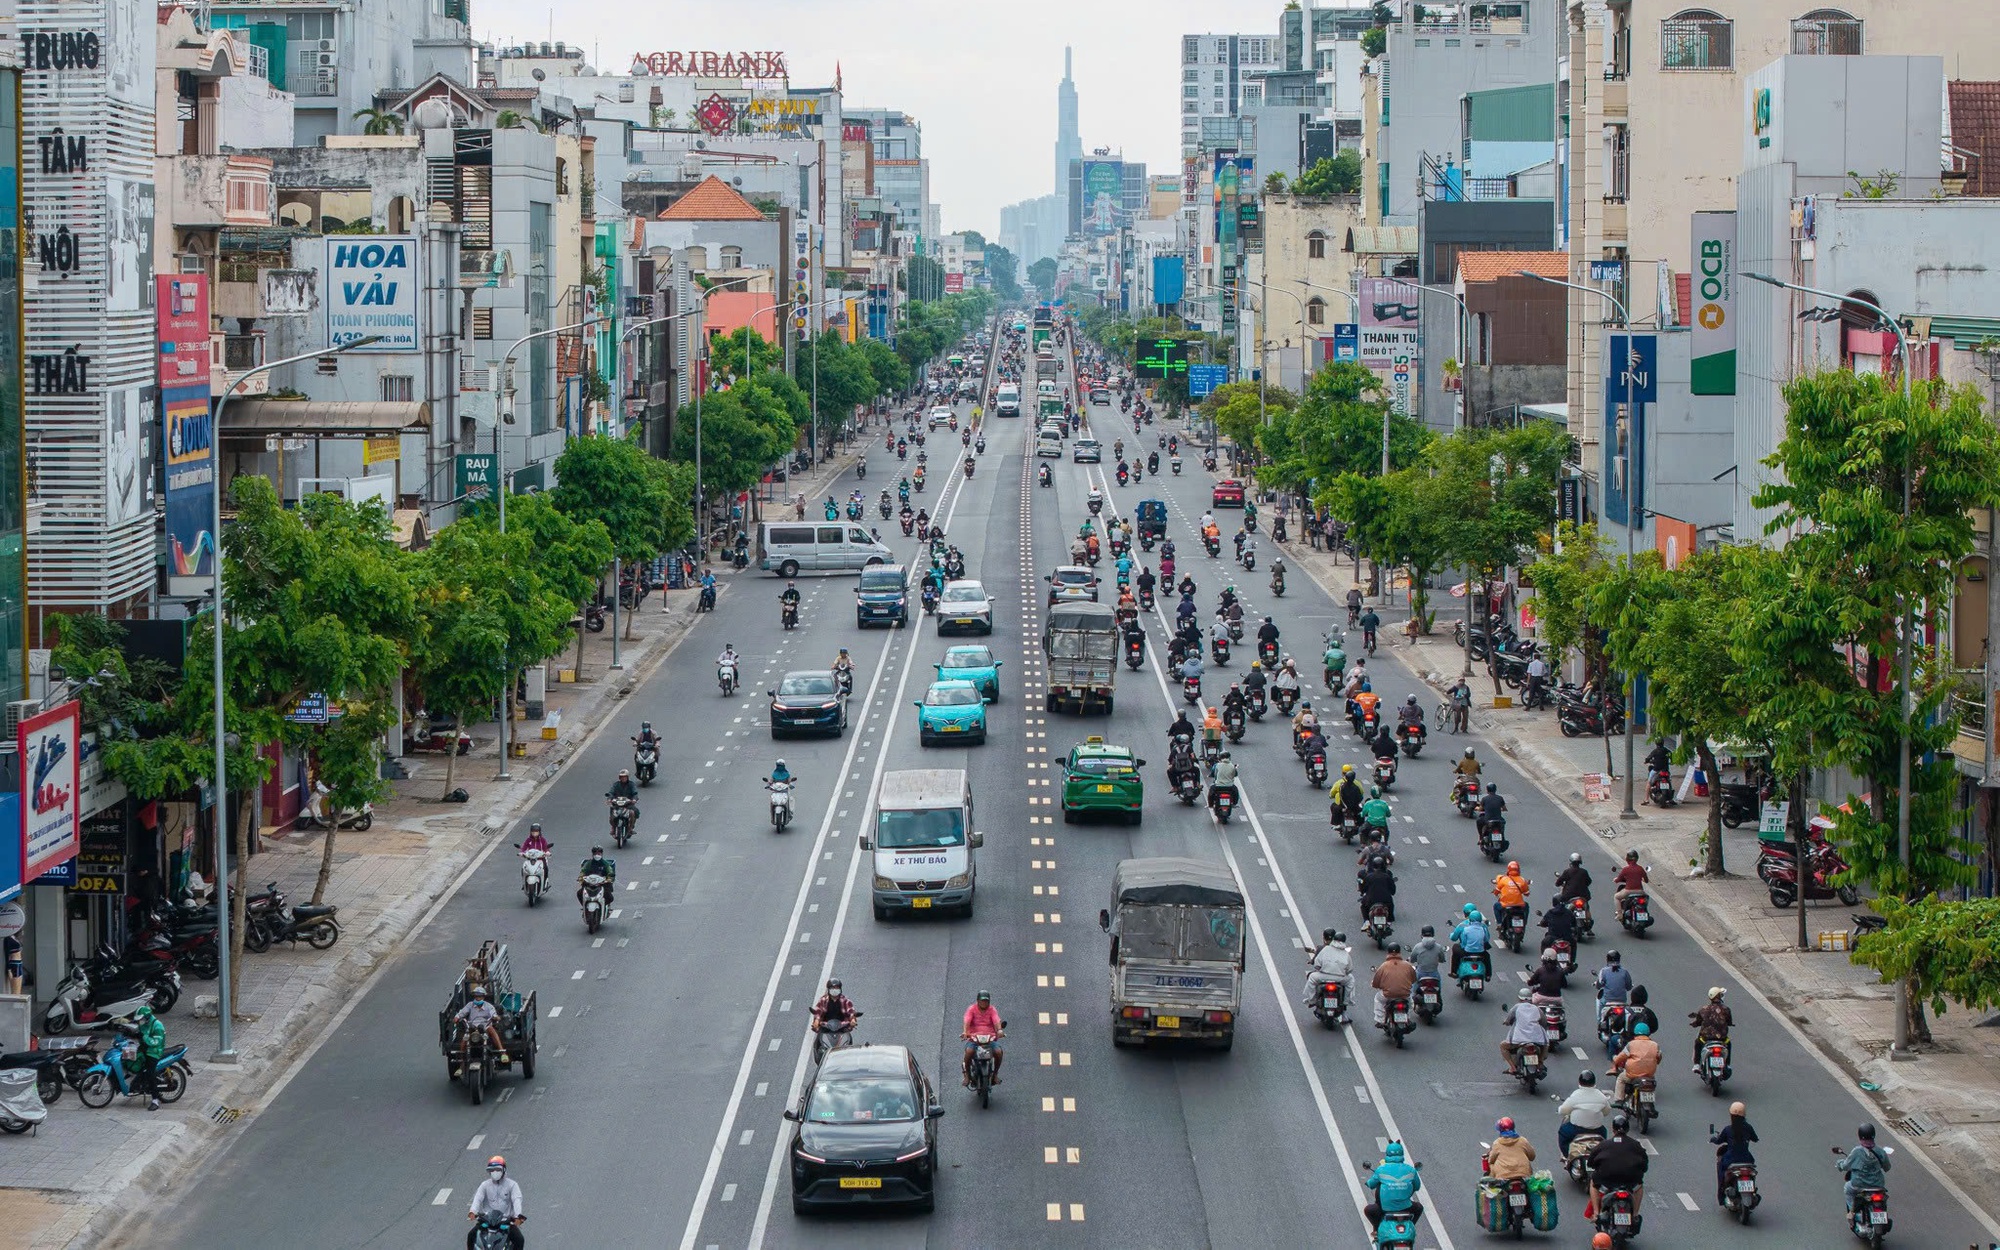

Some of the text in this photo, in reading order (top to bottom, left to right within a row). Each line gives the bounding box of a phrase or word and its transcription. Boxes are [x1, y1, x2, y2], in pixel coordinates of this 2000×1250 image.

[20, 32, 100, 70] TRUNG
[628, 51, 784, 74] AGRIBANK
[750, 99, 819, 115] AN HUY
[38, 127, 89, 174] TÂM
[40, 226, 79, 279] NỘI
[334, 244, 407, 268] HOA
[1701, 240, 1722, 300] OCB
[343, 272, 398, 306] VẢI
[1363, 333, 1399, 344] THANH
[1363, 347, 1379, 359] ĐIỆN
[31, 342, 90, 393] THẤT
[1621, 371, 1648, 389] PNJ
[181, 414, 210, 455] JOTUN
[466, 458, 490, 469] RAU
[468, 469, 487, 482] MÁ
[894, 857, 905, 865] XE
[908, 855, 926, 865] THƯ
